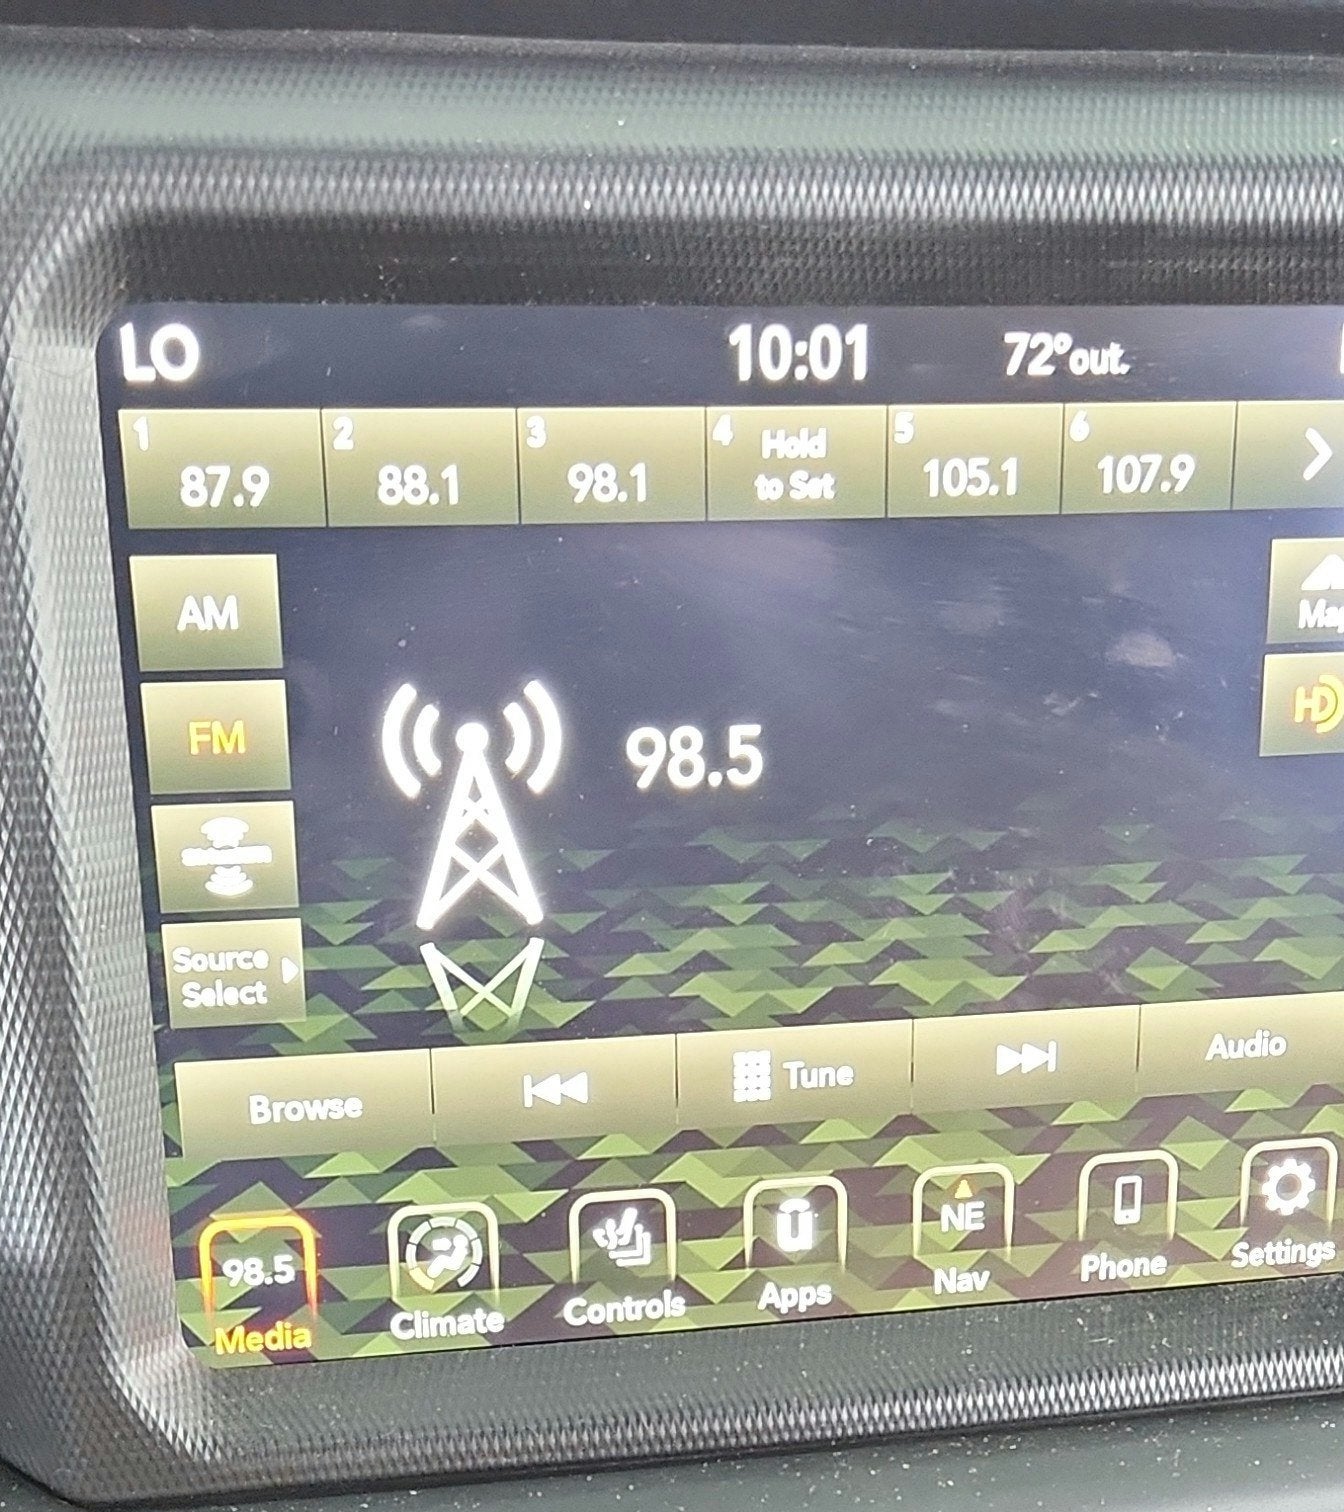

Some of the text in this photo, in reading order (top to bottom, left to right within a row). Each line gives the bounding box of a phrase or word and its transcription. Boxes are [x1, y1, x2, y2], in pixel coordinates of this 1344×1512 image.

[119, 321, 201, 383] LO
[729, 323, 868, 382] 10:01
[133, 418, 151, 451] 1
[332, 417, 355, 450] 2
[525, 416, 548, 449] 3
[712, 415, 735, 446] 4
[760, 425, 829, 459] Hold
[893, 413, 915, 445] 5
[1069, 412, 1091, 442] 6
[180, 464, 270, 508] 87.9
[377, 462, 459, 506] 88.1
[567, 462, 647, 504] 98.1
[753, 469, 835, 501] to Set
[923, 456, 1018, 498] 105.1
[1097, 453, 1196, 495] 107.9
[176, 594, 239, 632] AM
[189, 719, 246, 756] FM
[625, 723, 764, 790] 98.5
[170, 943, 272, 975] Source
[181, 978, 268, 1009] Select
[1204, 1028, 1287, 1061] Audio
[782, 1060, 854, 1090] Tune
[249, 1094, 363, 1125] Browse
[940, 1200, 985, 1234] NE
[220, 1253, 296, 1287] 98.5
[1080, 1251, 1169, 1283] Phone
[1229, 1238, 1340, 1273] Settings
[931, 1265, 991, 1295] Nav
[562, 1289, 687, 1326] Controls
[757, 1281, 833, 1314] Apps
[212, 1324, 313, 1356] Media
[388, 1308, 506, 1341] Climate
